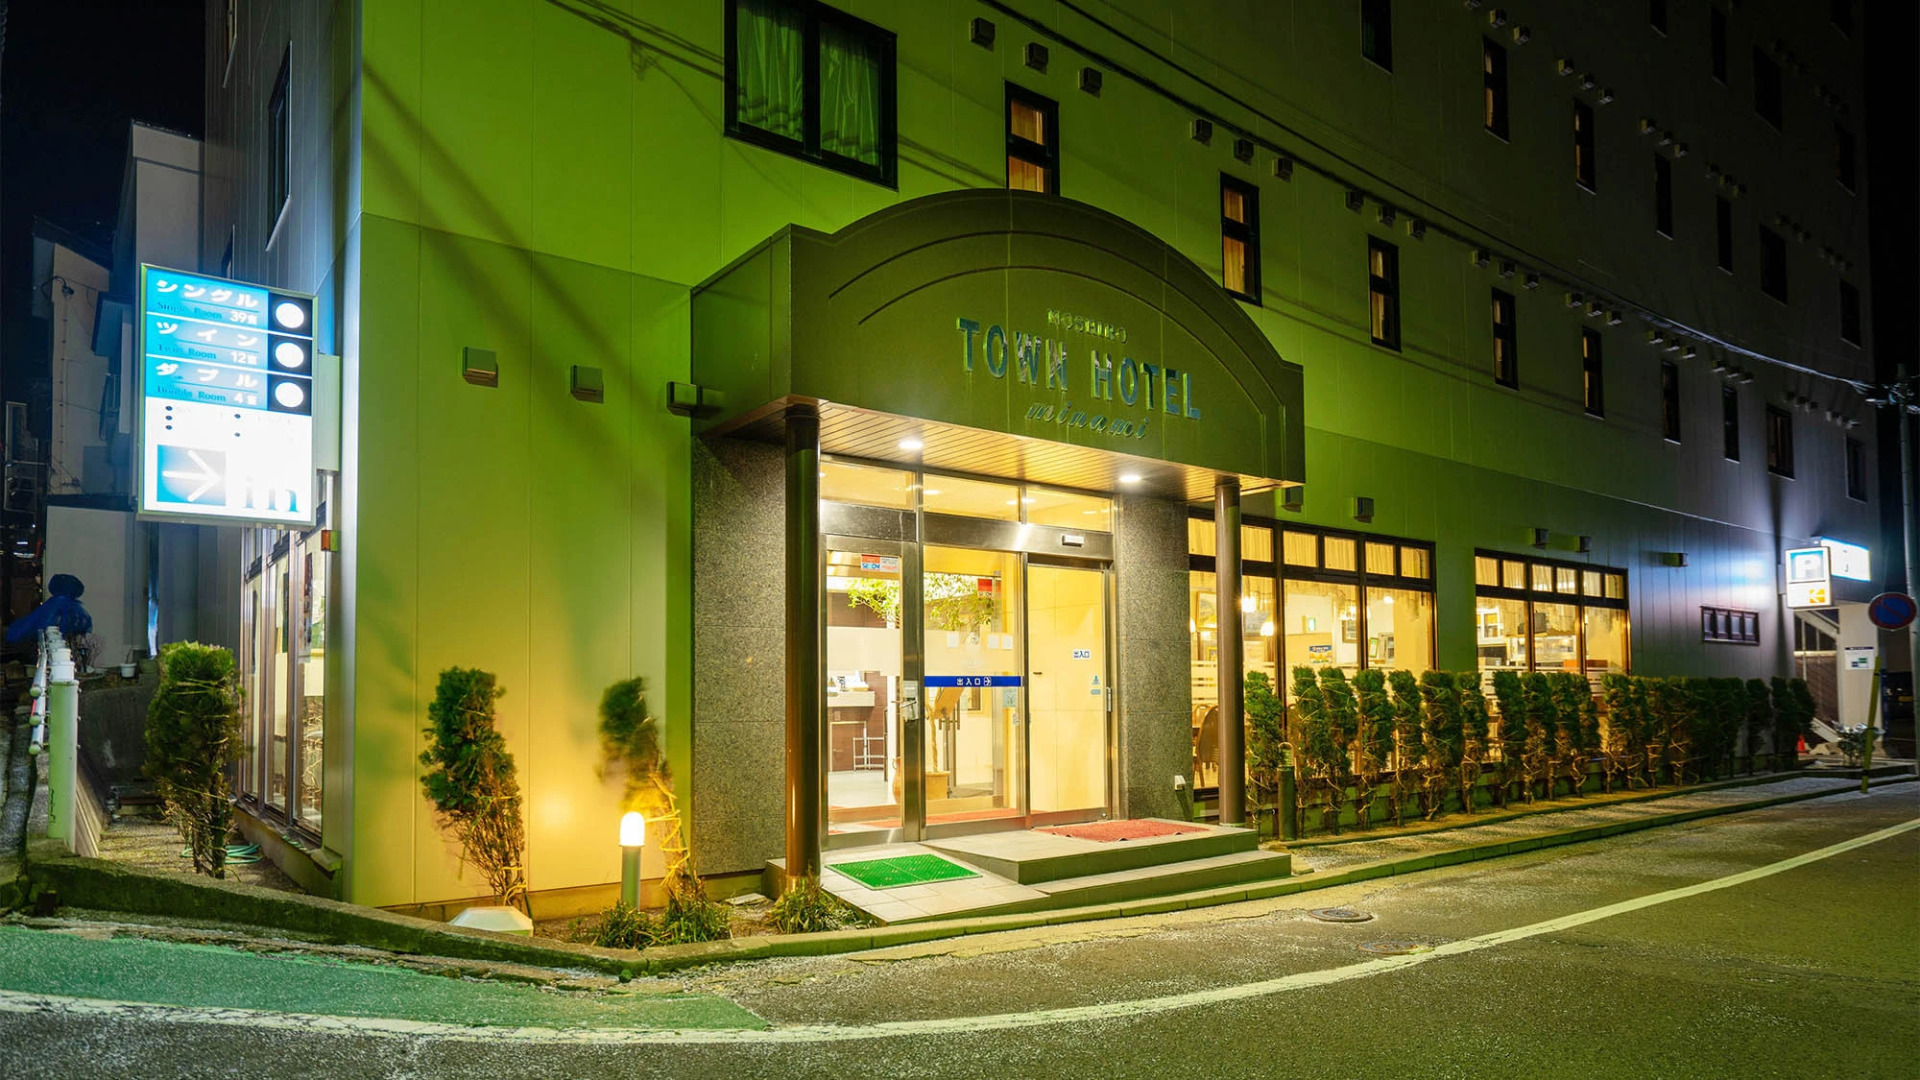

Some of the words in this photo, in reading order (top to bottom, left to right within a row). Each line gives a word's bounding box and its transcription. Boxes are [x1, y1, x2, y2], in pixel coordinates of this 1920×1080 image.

[156, 280, 259, 308] シングル
[156, 322, 259, 347] ツイン
[188, 348, 217, 359] Room
[156, 363, 259, 388] ダブル
[956, 317, 1068, 391] TOWN
[1091, 349, 1201, 420] HOTEL
[198, 391, 226, 402] Room
[1024, 401, 1149, 439] minami
[956, 677, 982, 686] 出入口
